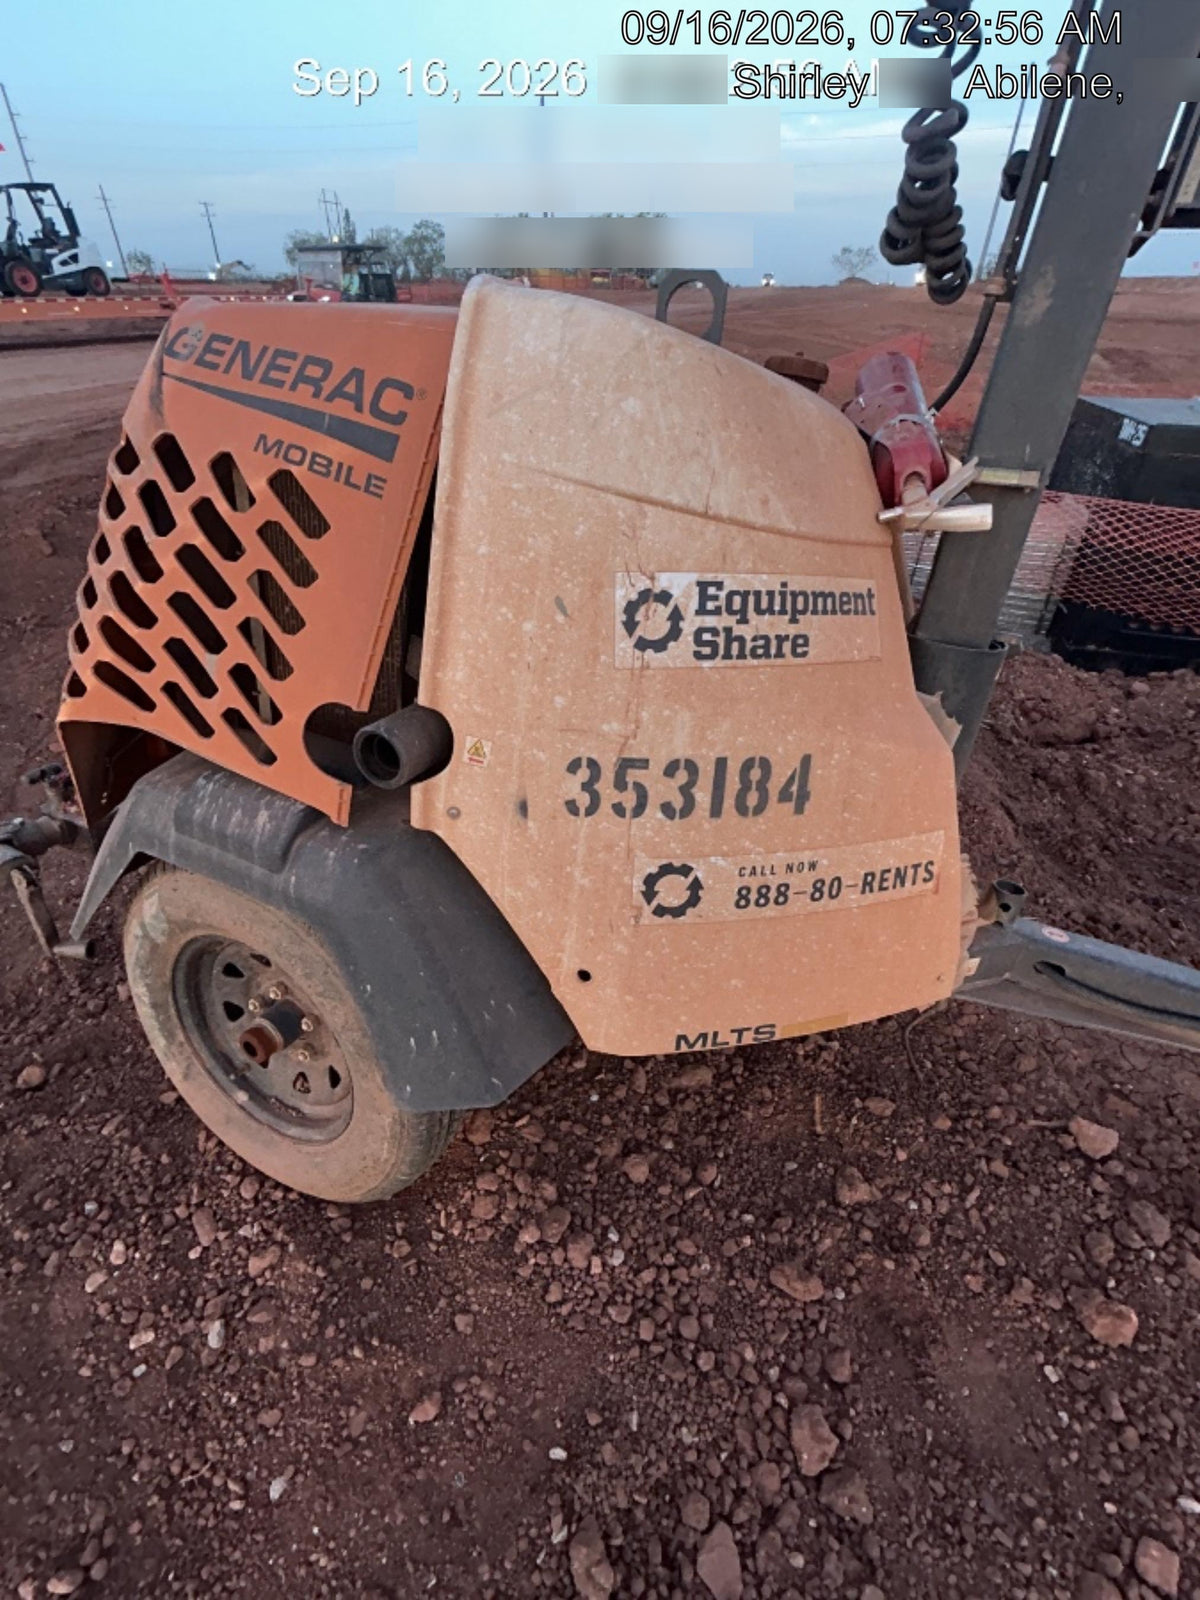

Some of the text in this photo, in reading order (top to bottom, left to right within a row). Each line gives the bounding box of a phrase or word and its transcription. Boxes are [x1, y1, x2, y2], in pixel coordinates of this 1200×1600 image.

[164, 326, 415, 426] GENERAC
[253, 433, 388, 500] MOBILE
[694, 580, 876, 625] Equipment
[692, 626, 810, 660] Share
[563, 753, 813, 820] 353184
[734, 860, 935, 909] 888-80-RENTS
[738, 859, 819, 878] CALL NOW
[674, 1023, 777, 1051] MLTS
